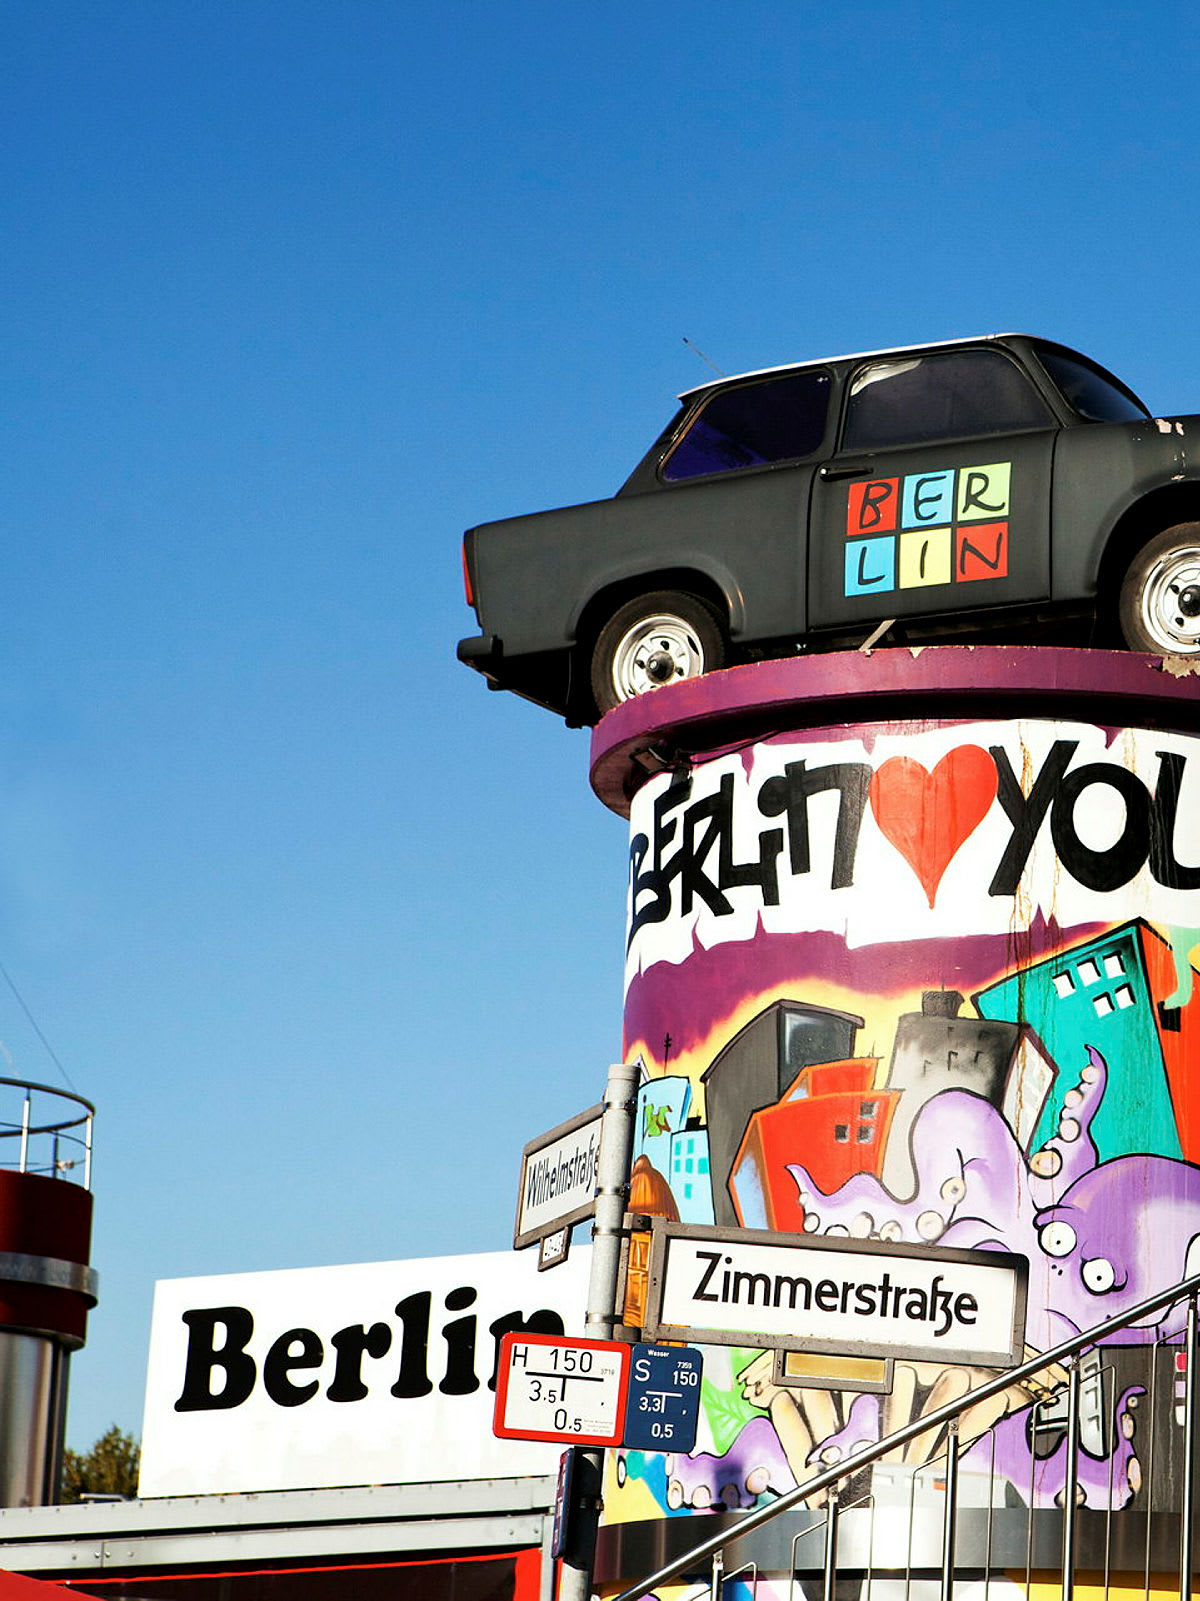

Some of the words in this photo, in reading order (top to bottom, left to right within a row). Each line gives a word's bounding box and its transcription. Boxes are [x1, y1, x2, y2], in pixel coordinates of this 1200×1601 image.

[859, 472, 1006, 530] BER
[857, 532, 1003, 586] LIN
[692, 1250, 979, 1337] Zimmerstraße
[512, 1345, 529, 1368] H
[549, 1348, 593, 1373] 150
[634, 1358, 652, 1382] S
[673, 1370, 698, 1387] 150
[651, 1422, 674, 1438] 0,5
